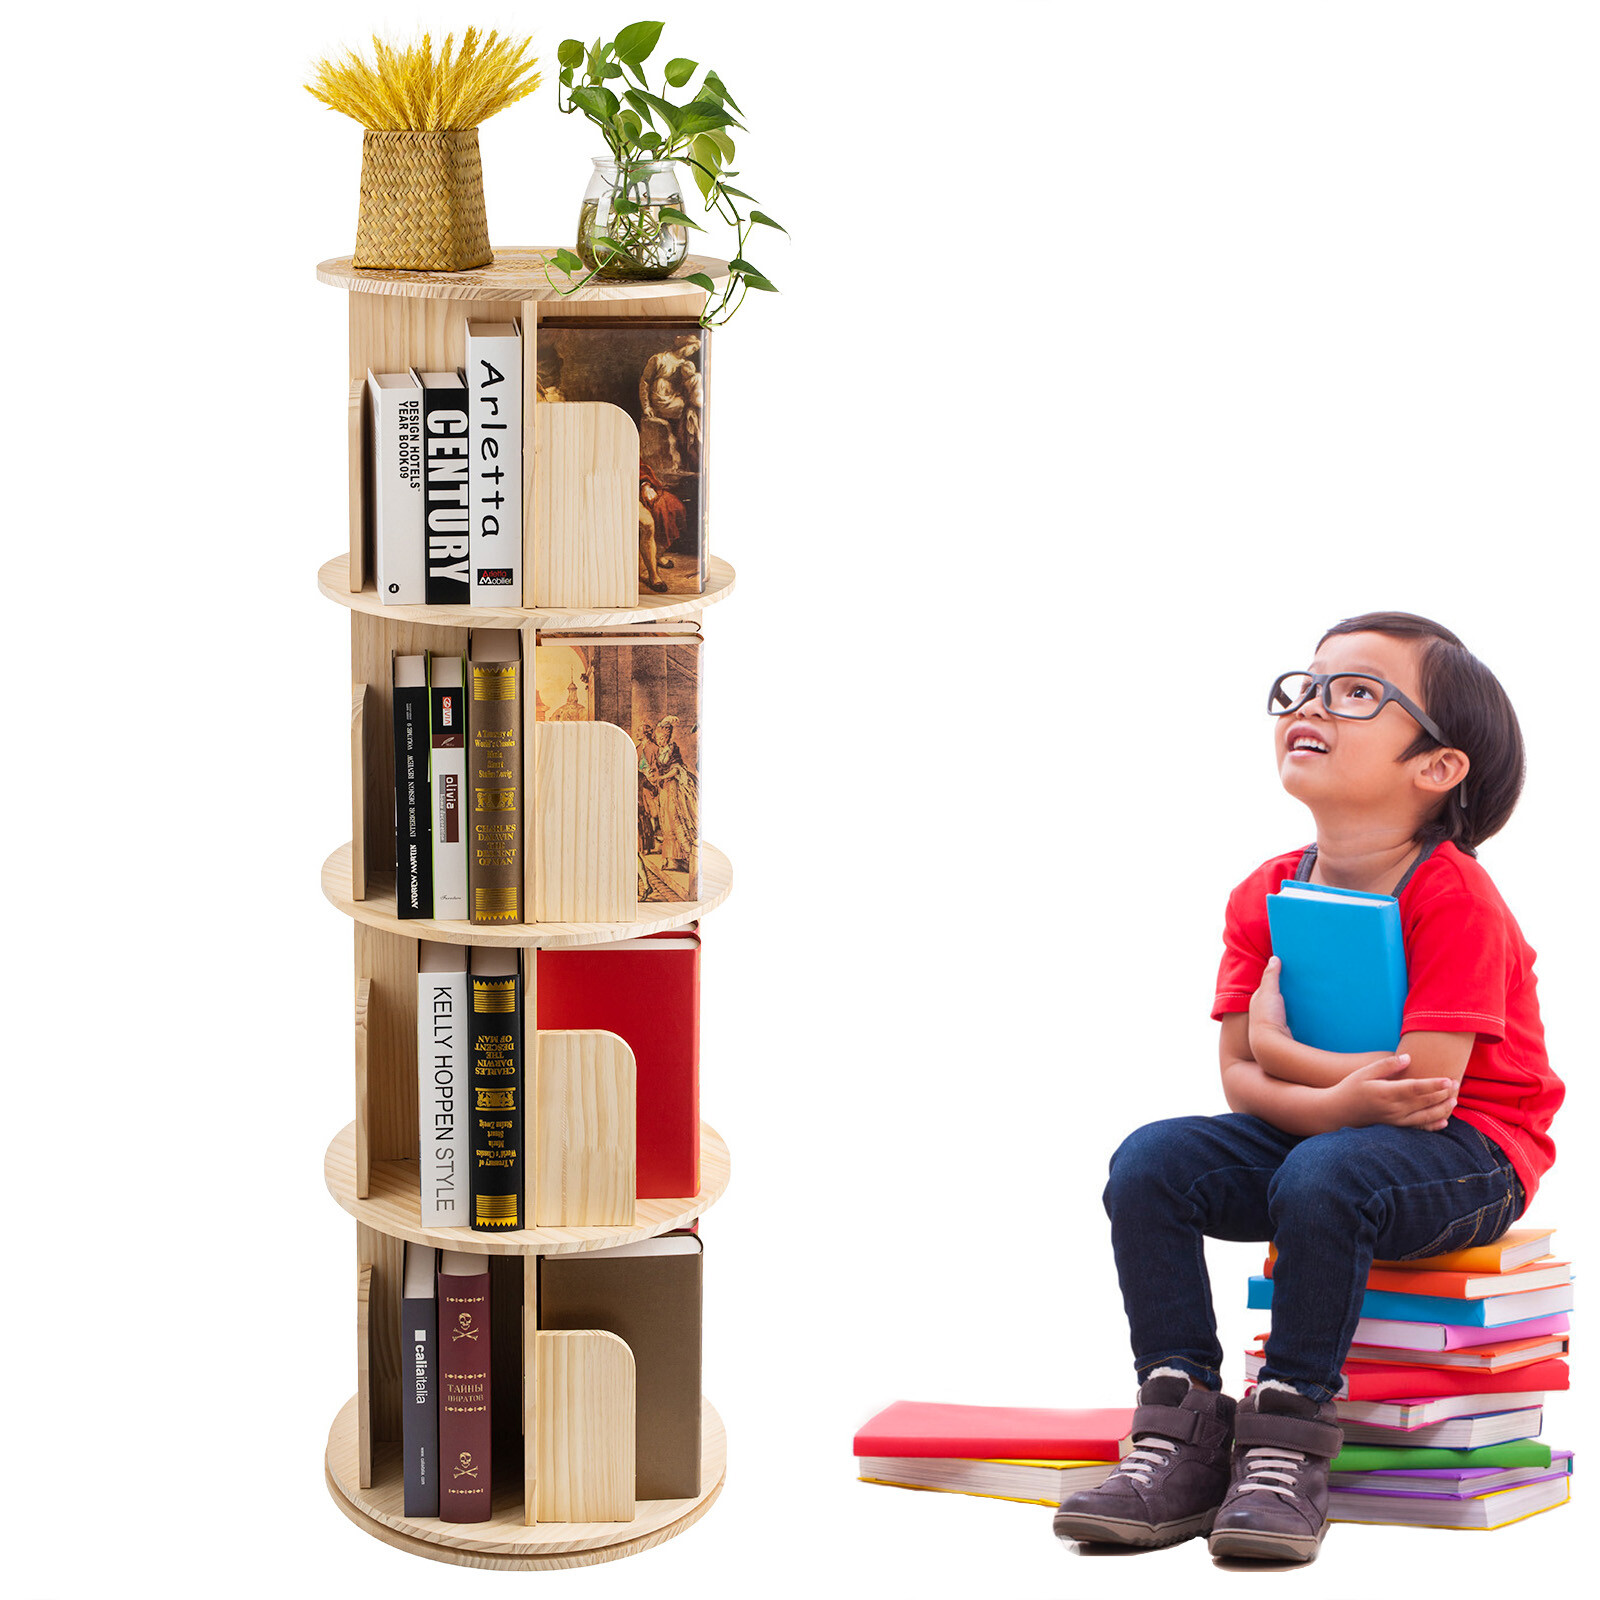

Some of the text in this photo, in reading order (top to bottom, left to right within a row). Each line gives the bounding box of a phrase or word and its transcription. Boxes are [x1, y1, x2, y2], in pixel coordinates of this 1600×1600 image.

[409, 401, 420, 441] DESIGN
[398, 401, 409, 479] YEAR BOOK09
[480, 359, 507, 538] Arletta
[426, 410, 469, 583] CENTURY
[406, 727, 414, 751] VOLUME
[407, 755, 415, 779] REVIEW
[408, 781, 416, 805] DESIGN
[446, 776, 457, 809] olivia
[409, 807, 417, 837] INTERIOR
[475, 824, 517, 832] CHARLES
[410, 844, 418, 874] MARTIN
[411, 874, 419, 909] ANDREW
[474, 1043, 514, 1051] DESCENT
[478, 1035, 512, 1043] OF MAN
[477, 1059, 513, 1067] DARWIN
[485, 1051, 504, 1059] THE
[475, 1067, 516, 1075] CHARLES
[433, 987, 455, 1211] KELLY HOPPEN STYLE
[415, 1344, 428, 1404] caliaitalia
[447, 1384, 483, 1393] ТАЙНЫ
